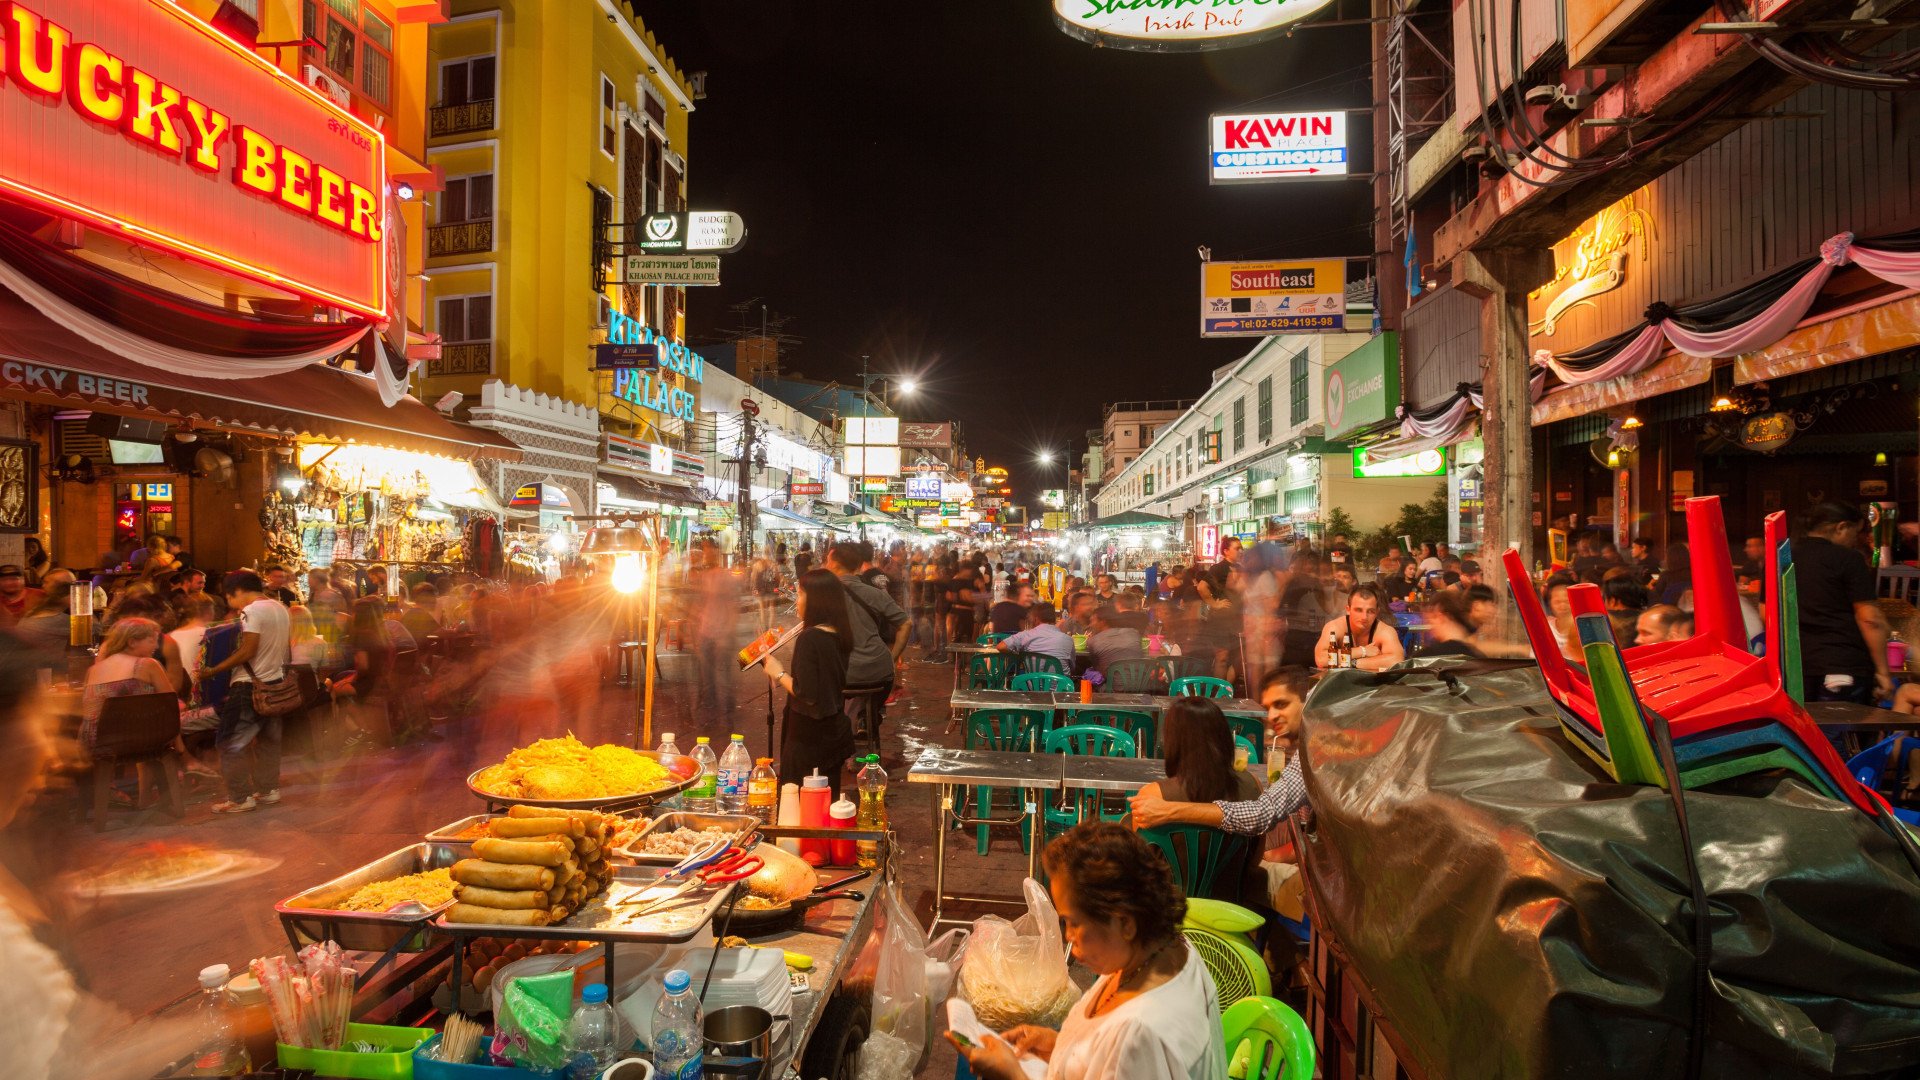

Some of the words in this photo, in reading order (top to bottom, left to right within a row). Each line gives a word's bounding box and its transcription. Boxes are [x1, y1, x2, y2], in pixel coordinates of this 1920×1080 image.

[1145, 12, 1194, 32] Irish
[1204, 10, 1243, 30] Pub
[0, 3, 230, 172] UCKY
[234, 124, 382, 243] BEER
[1225, 116, 1332, 149] KAWIN
[698, 216, 733, 224] BUDGET
[629, 272, 662, 280] KHAOSAN
[664, 272, 691, 280] PALACE
[693, 271, 715, 280] HOTEL
[1231, 271, 1314, 289] Southeast
[78, 373, 149, 405] BEER
[612, 368, 695, 423] PALACE
[1347, 374, 1383, 404] EXCHANGE
[909, 479, 940, 491] BAG
